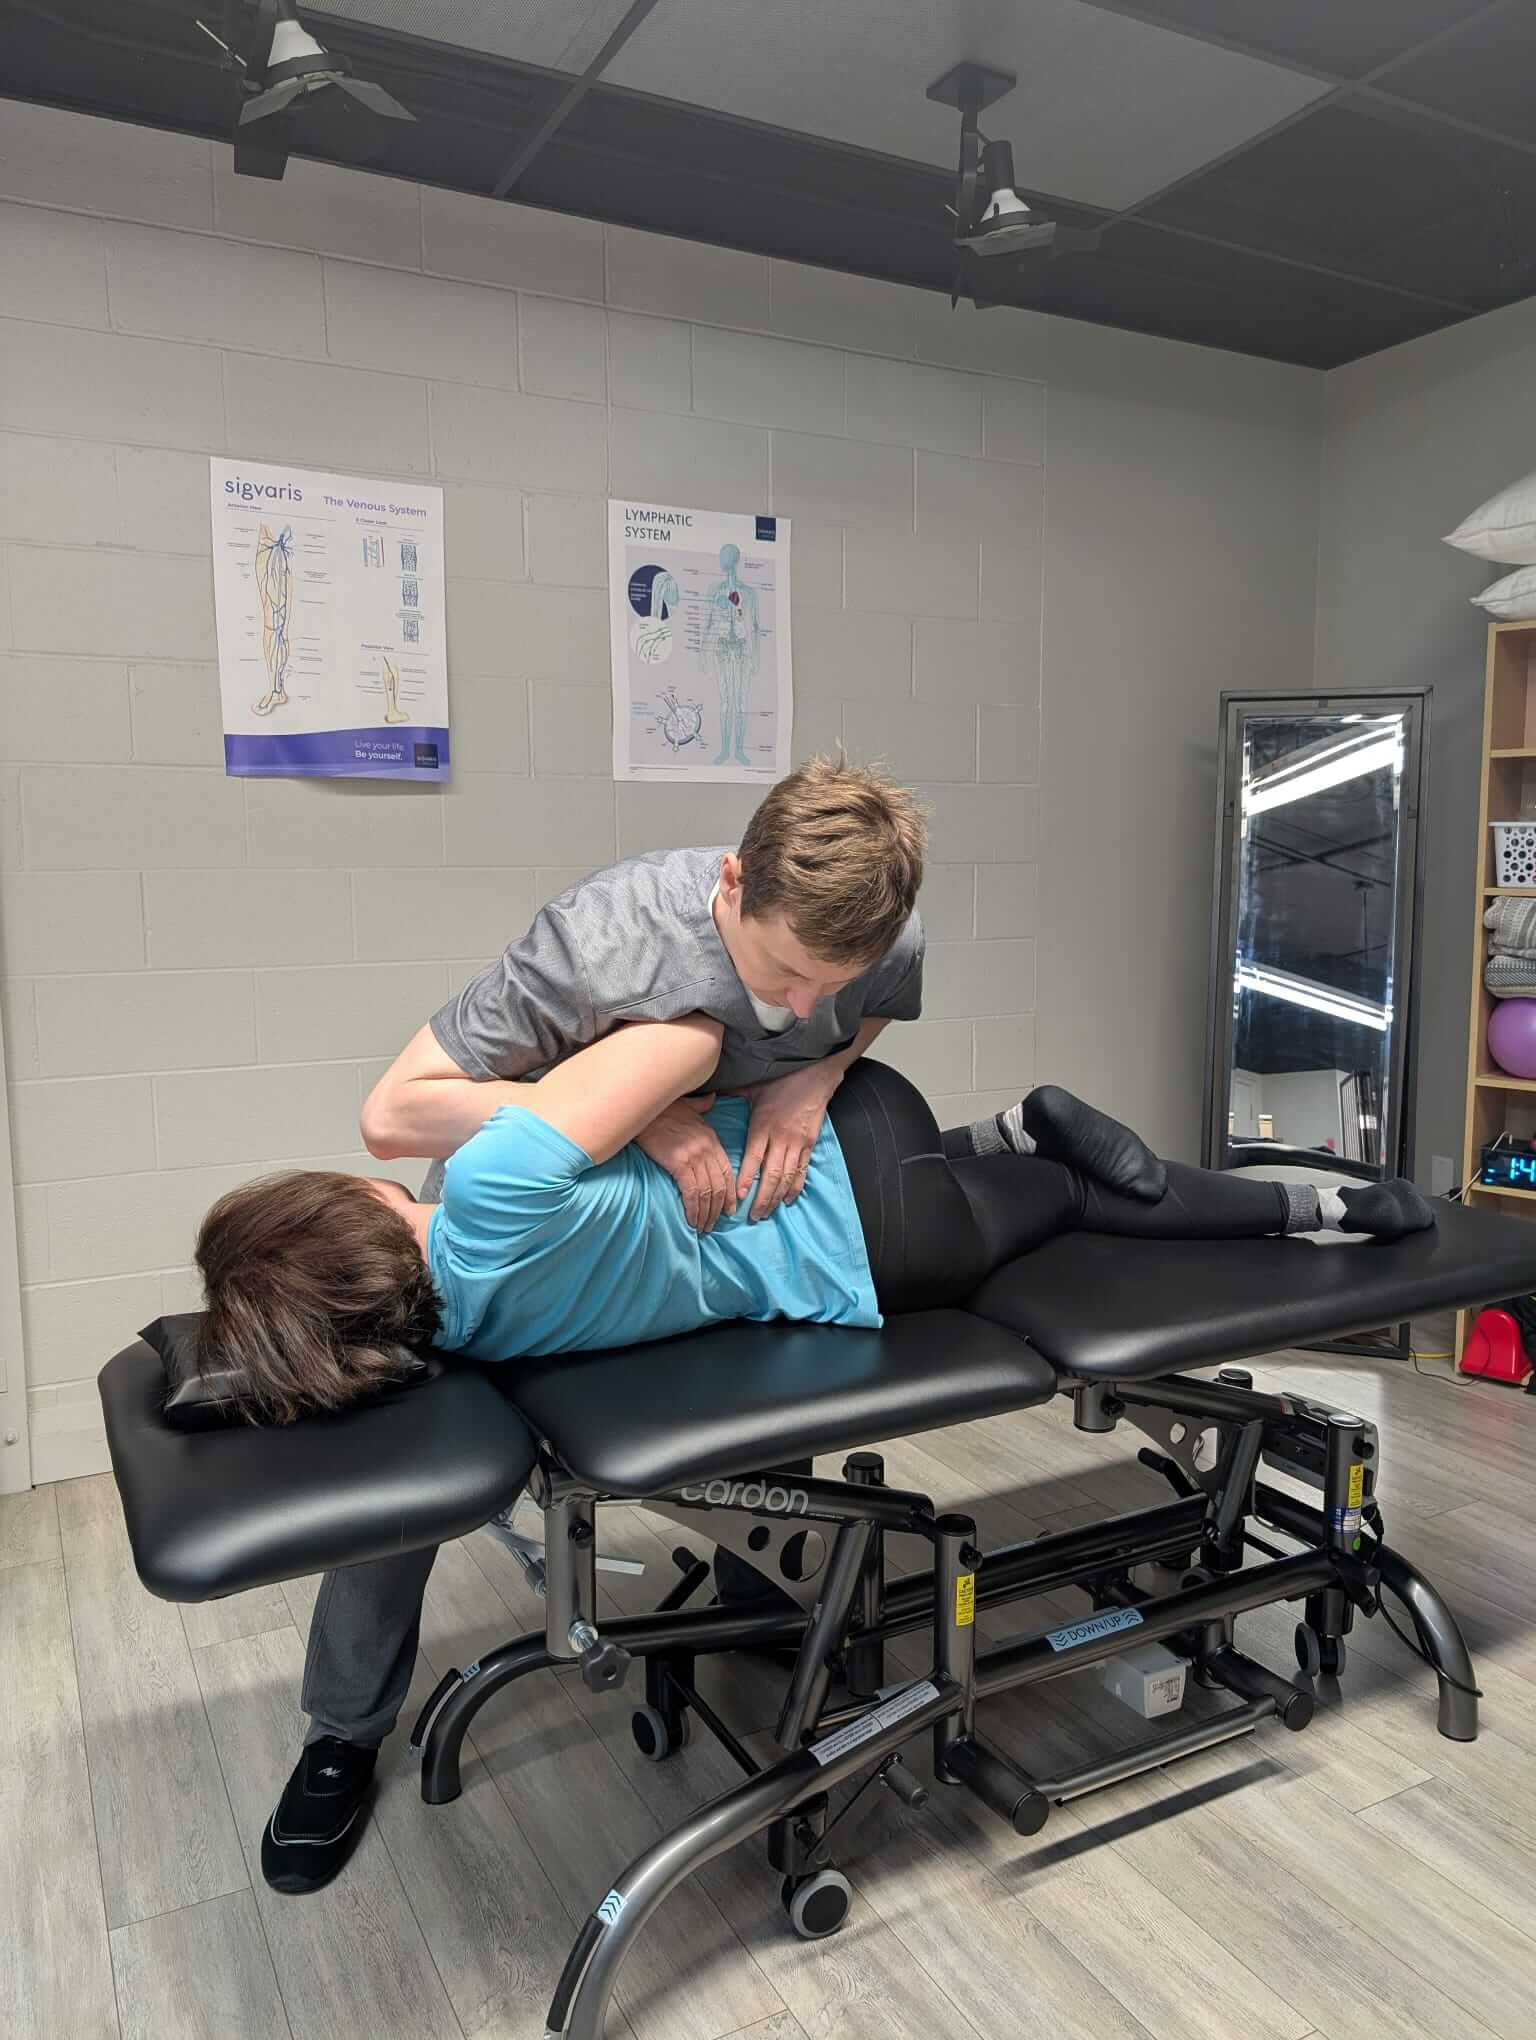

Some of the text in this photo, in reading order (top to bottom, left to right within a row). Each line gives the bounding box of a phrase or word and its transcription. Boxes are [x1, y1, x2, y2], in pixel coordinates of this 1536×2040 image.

[224, 476, 303, 501] sigvaris
[323, 496, 427, 517] The Venous System
[625, 508, 693, 527] LYMPHATIC
[625, 526, 671, 541] SYSTEM
[355, 740, 371, 748] Live
[355, 750, 366, 758] Be
[1068, 1615, 1121, 1641] DOWN/UP
